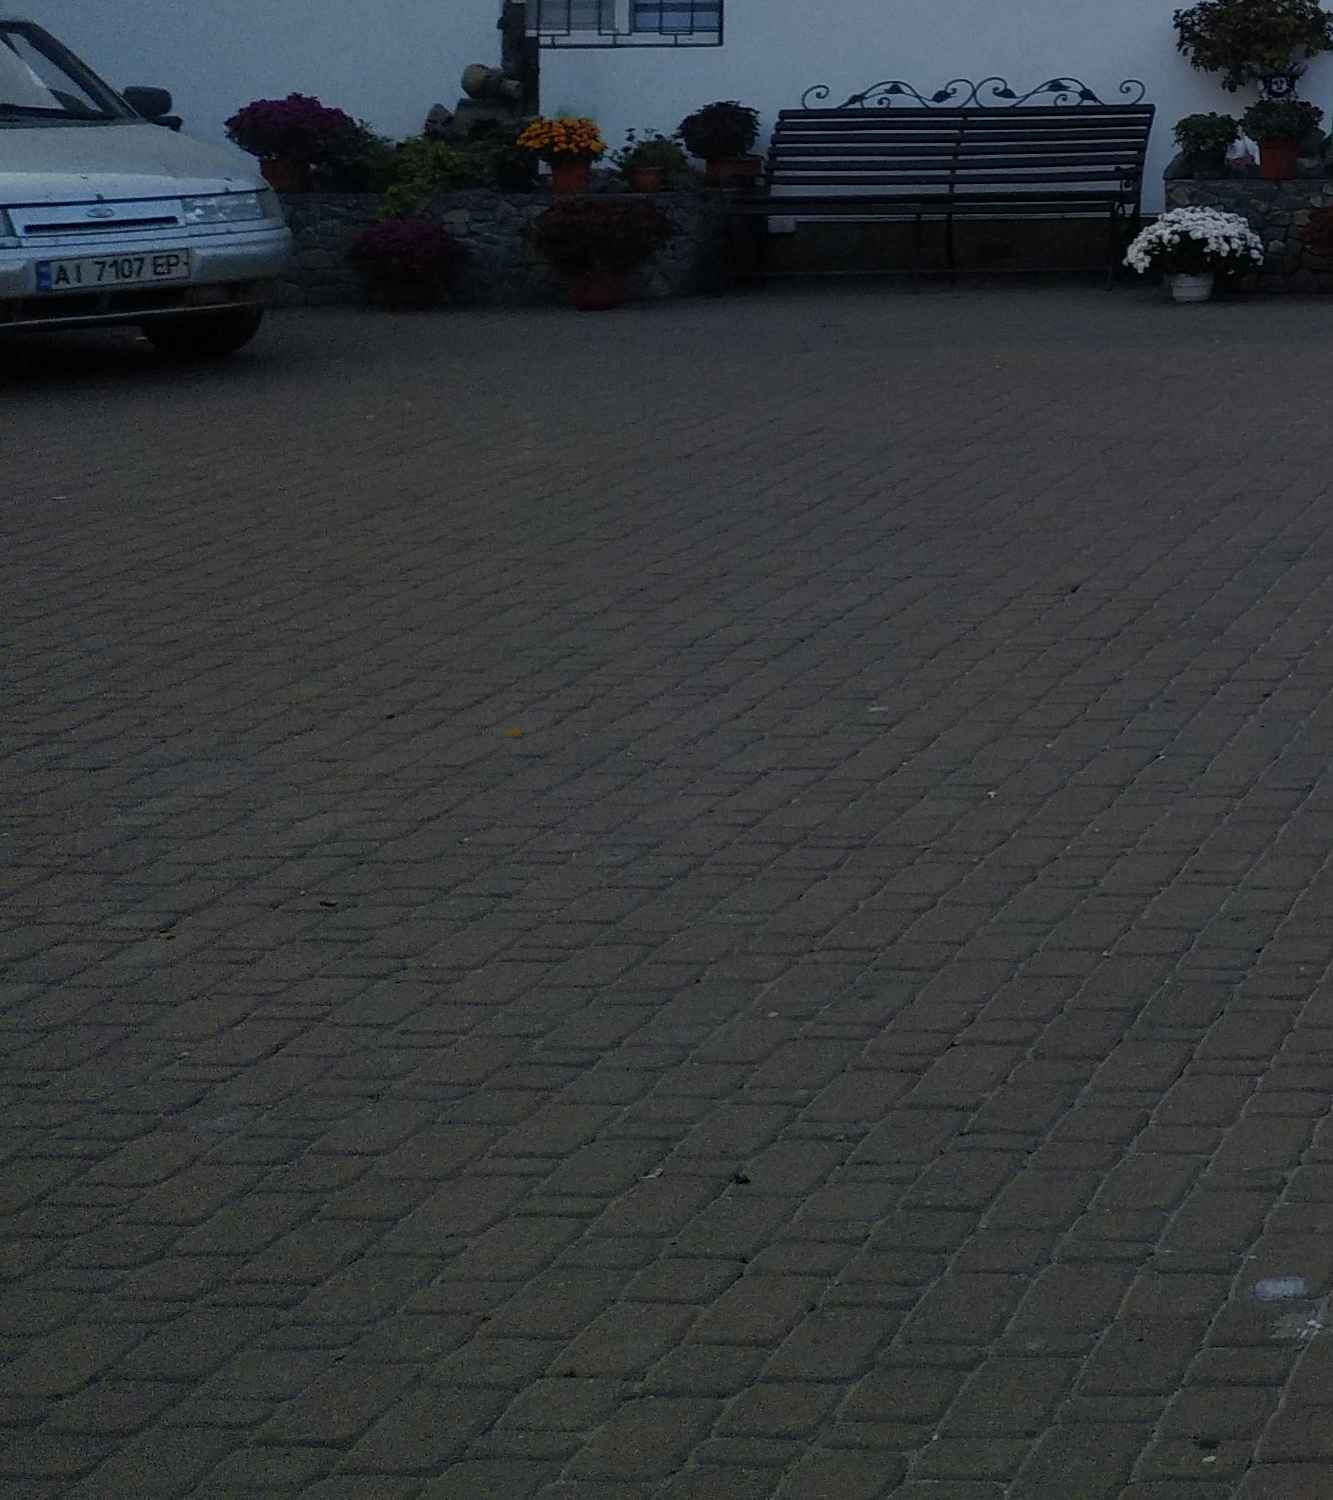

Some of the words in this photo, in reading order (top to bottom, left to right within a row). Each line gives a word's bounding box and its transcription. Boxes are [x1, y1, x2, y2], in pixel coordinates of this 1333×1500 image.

[55, 263, 82, 285] AI
[94, 256, 145, 282] 7107
[152, 253, 181, 276] EP
